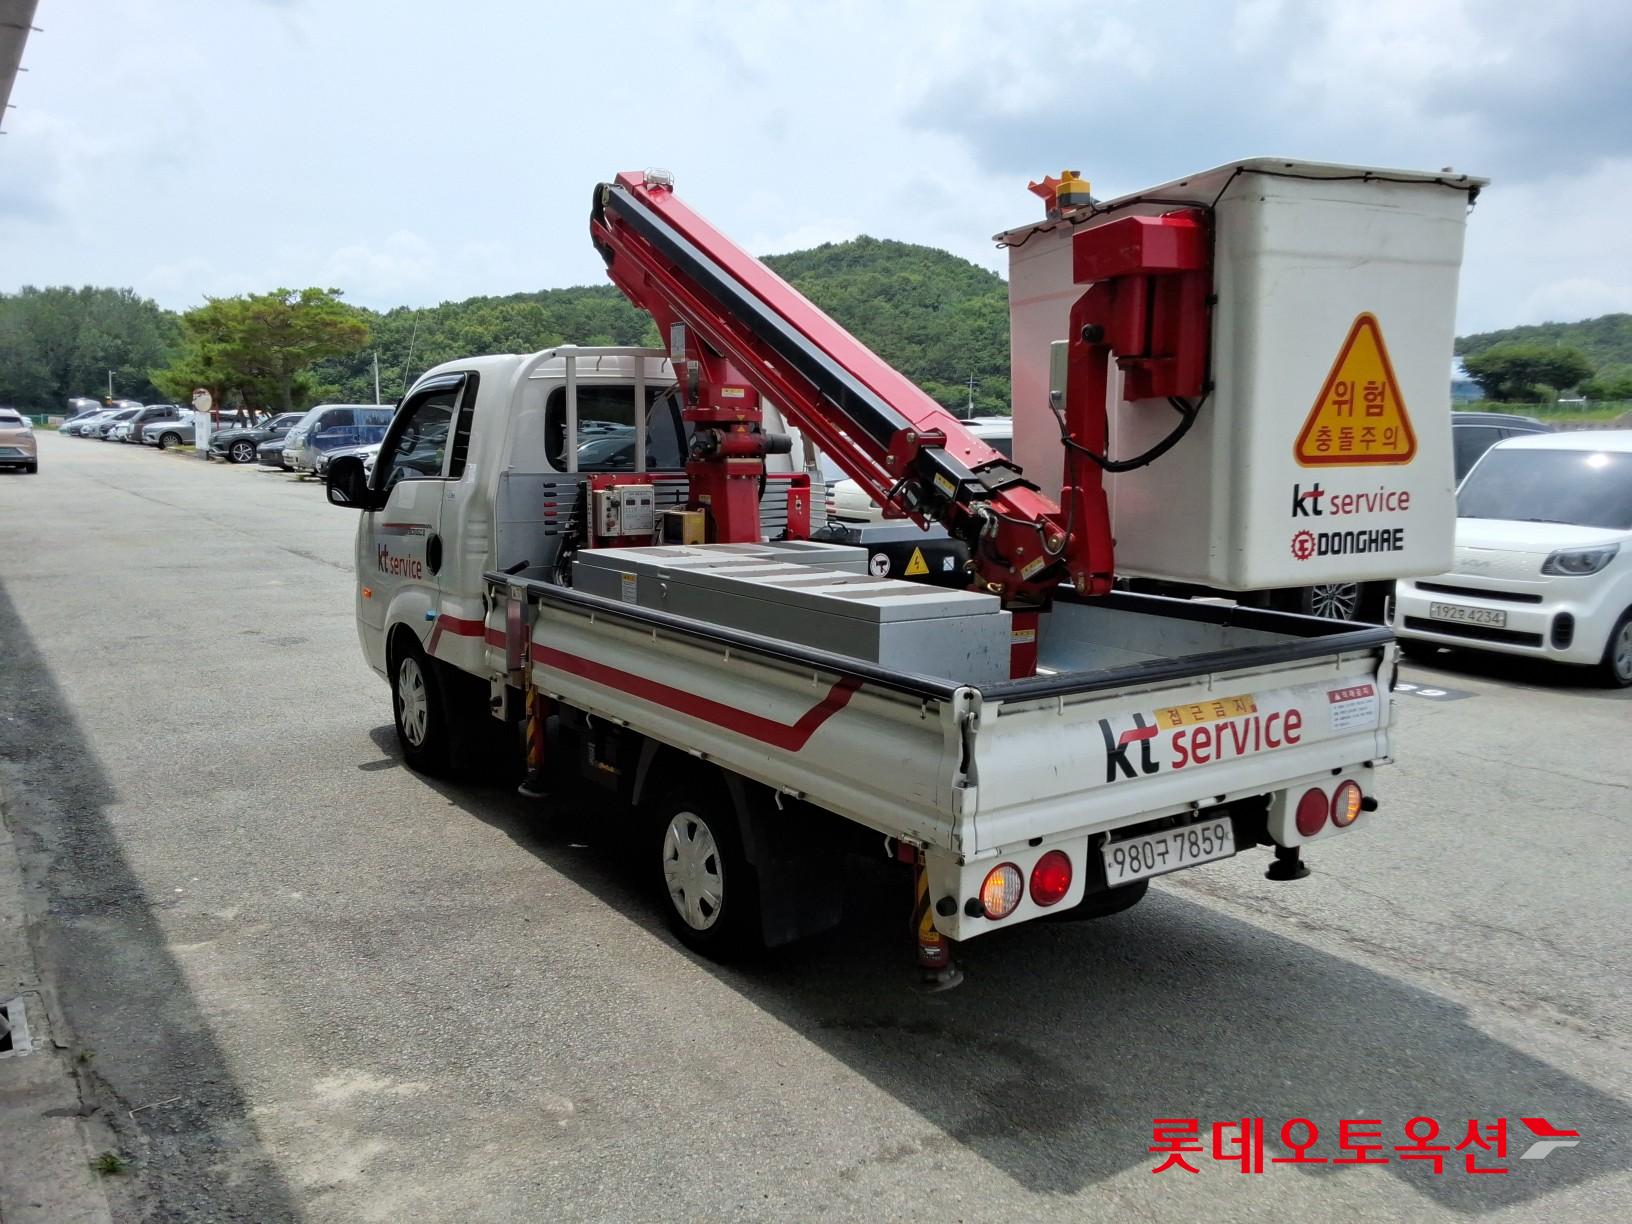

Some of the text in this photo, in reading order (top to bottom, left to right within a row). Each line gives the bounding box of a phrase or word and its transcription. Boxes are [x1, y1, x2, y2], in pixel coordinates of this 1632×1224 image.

[1331, 380, 1387, 418] 위험
[1291, 482, 1410, 518] kt service
[1317, 528, 1404, 556] DONGHAE
[378, 543, 422, 580] kt service
[1467, 609, 1500, 624] 4234
[1098, 704, 1303, 783] kt service
[1113, 823, 1226, 877] 980구 7859
